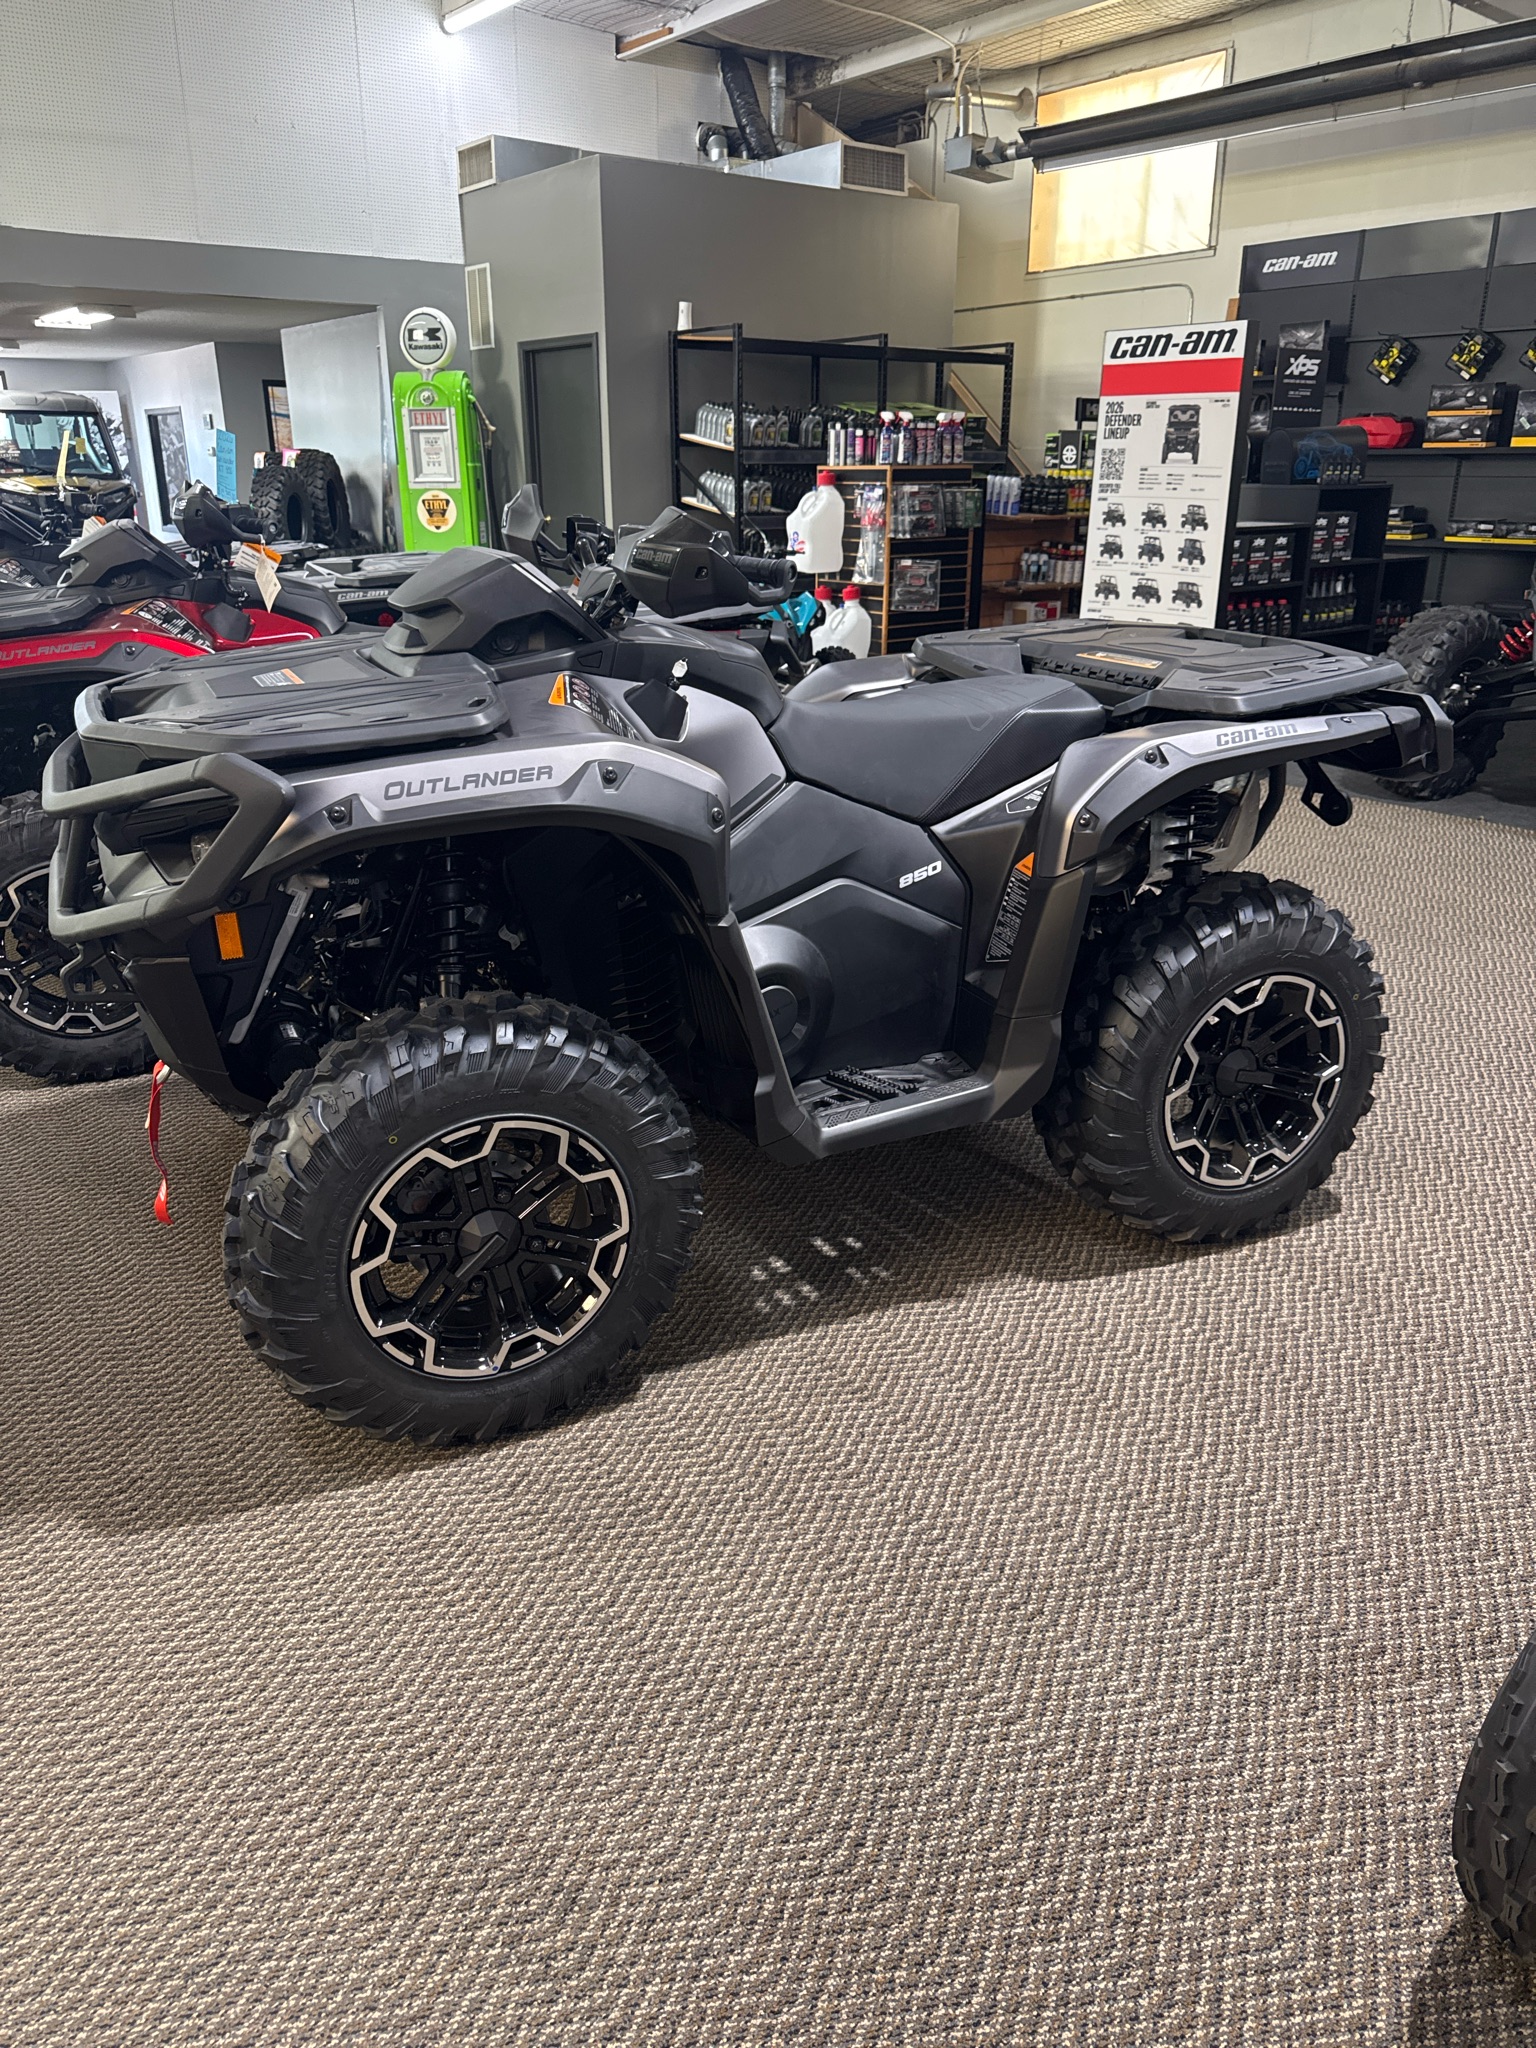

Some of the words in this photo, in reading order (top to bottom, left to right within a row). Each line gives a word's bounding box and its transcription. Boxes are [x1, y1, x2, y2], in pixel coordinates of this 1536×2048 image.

[1262, 251, 1338, 273] can-am
[1110, 328, 1238, 359] can-am
[1284, 354, 1322, 377] XPS
[1105, 401, 1125, 414] 2026
[413, 411, 446, 426] ETHYL
[1104, 414, 1142, 427] DEFENDER
[1103, 427, 1130, 440] LINEUP
[424, 500, 448, 510] ETHYL
[635, 549, 673, 564] can-am
[337, 589, 389, 601] can-am
[0, 640, 97, 660] UTLANDER
[1216, 723, 1298, 747] can-am
[384, 765, 553, 801] OUTLANDER
[899, 860, 942, 889] 850
